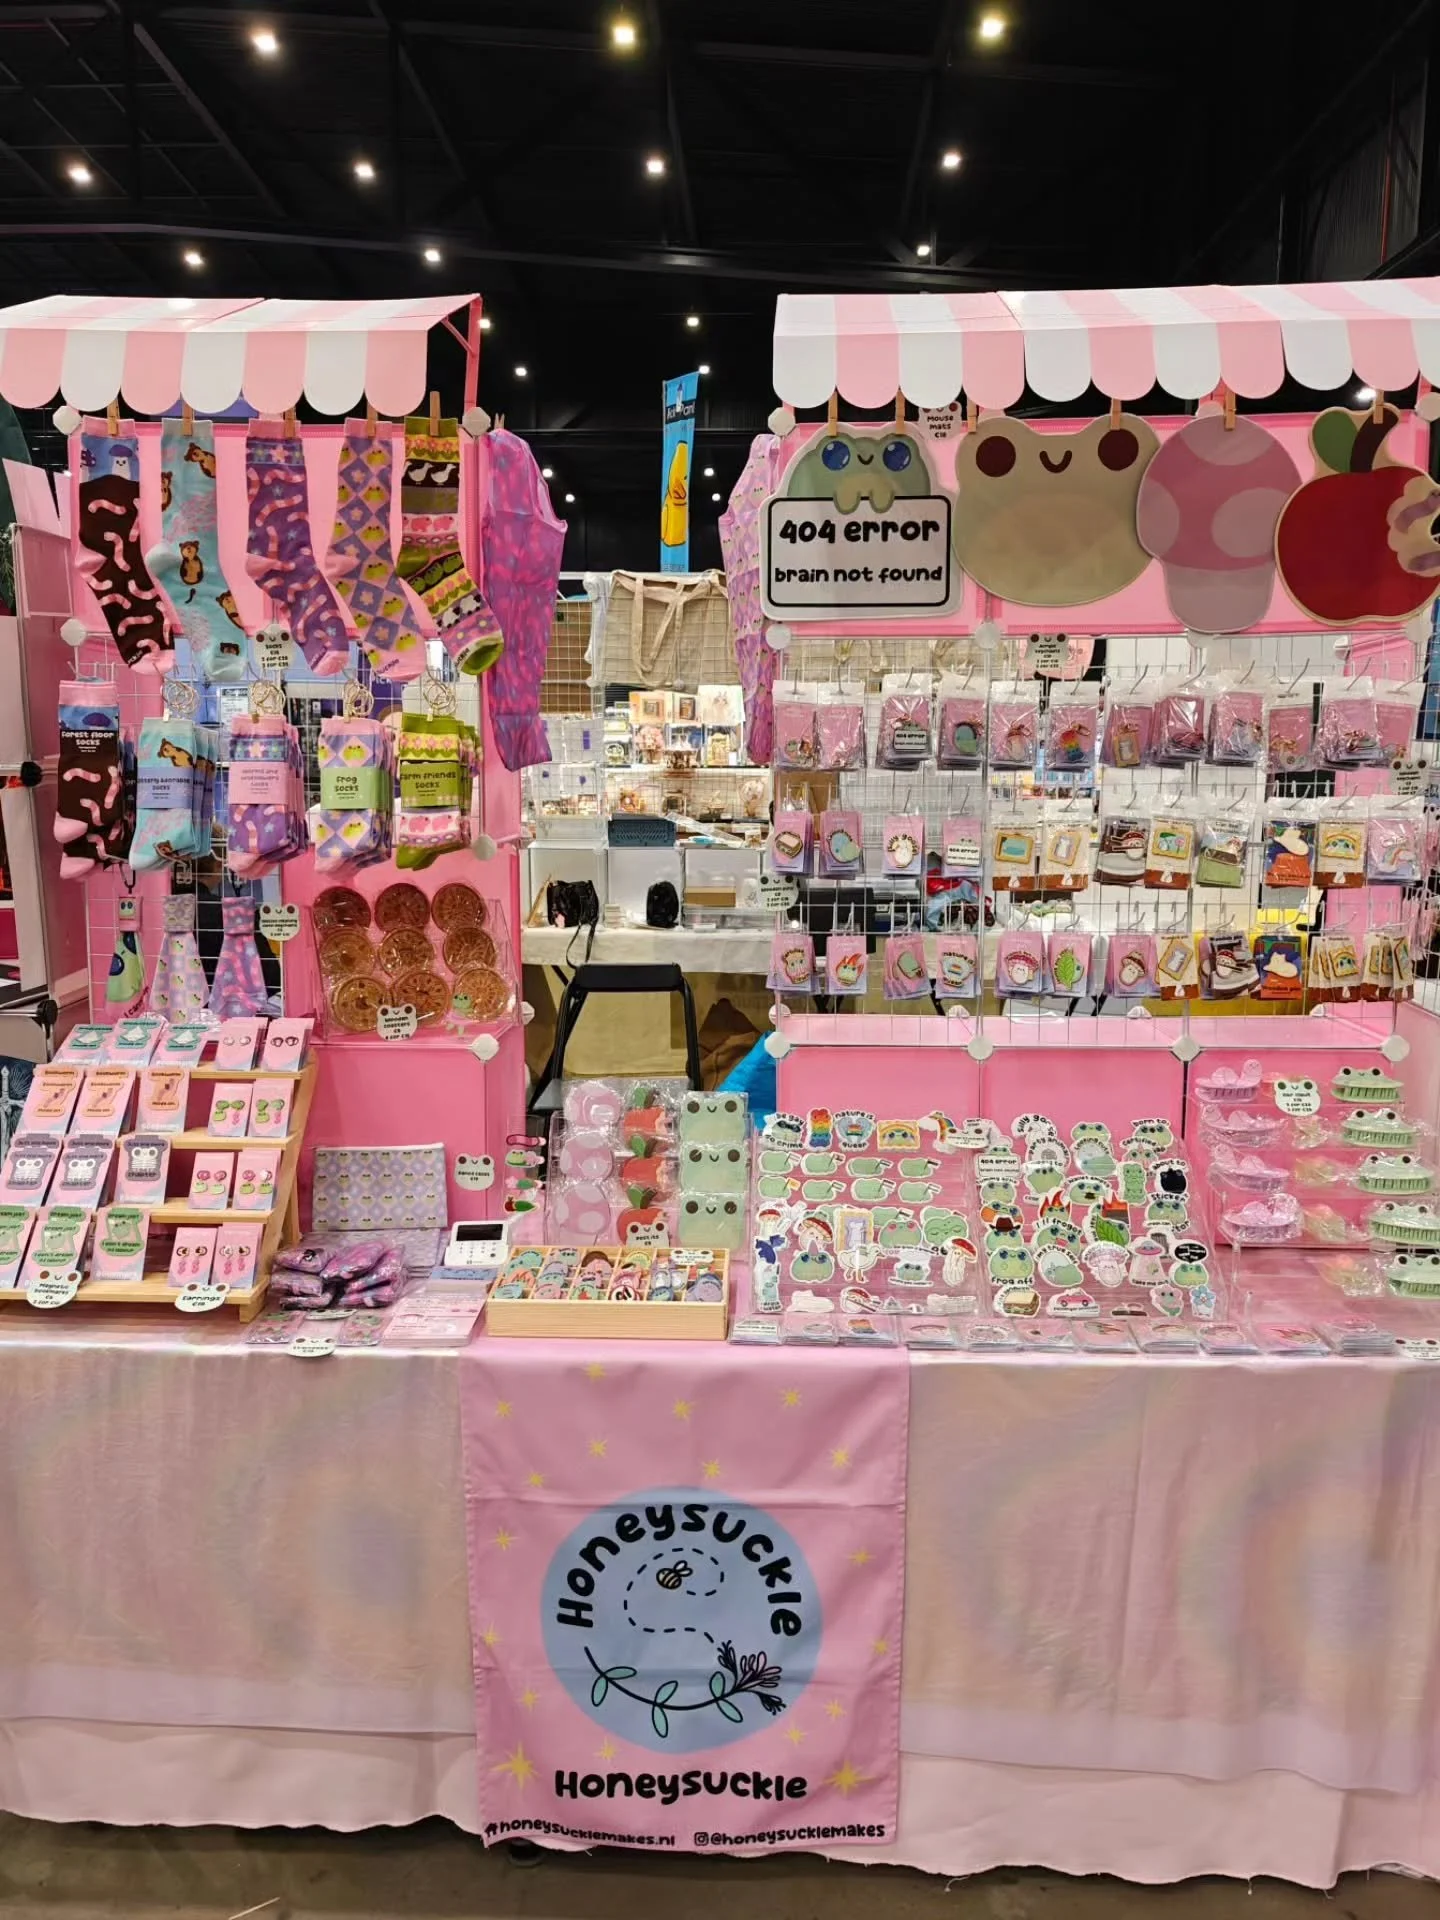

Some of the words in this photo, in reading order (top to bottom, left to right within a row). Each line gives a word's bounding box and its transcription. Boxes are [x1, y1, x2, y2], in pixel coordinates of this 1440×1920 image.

[779, 519, 836, 544] 404
[843, 520, 940, 542] error
[774, 567, 829, 582] brain
[833, 567, 873, 582] not
[878, 566, 943, 583] found
[423, 771, 456, 780] friends
[835, 1110, 866, 1118] nature
[776, 1140, 804, 1149] crime
[842, 1141, 867, 1149] queer
[557, 1504, 801, 1636] Honeysuckle
[555, 1770, 807, 1805] Honeysuckle
[500, 1818, 676, 1846] honeysucklemakes.nl
[710, 1823, 885, 1847] @honeysucklemakes
